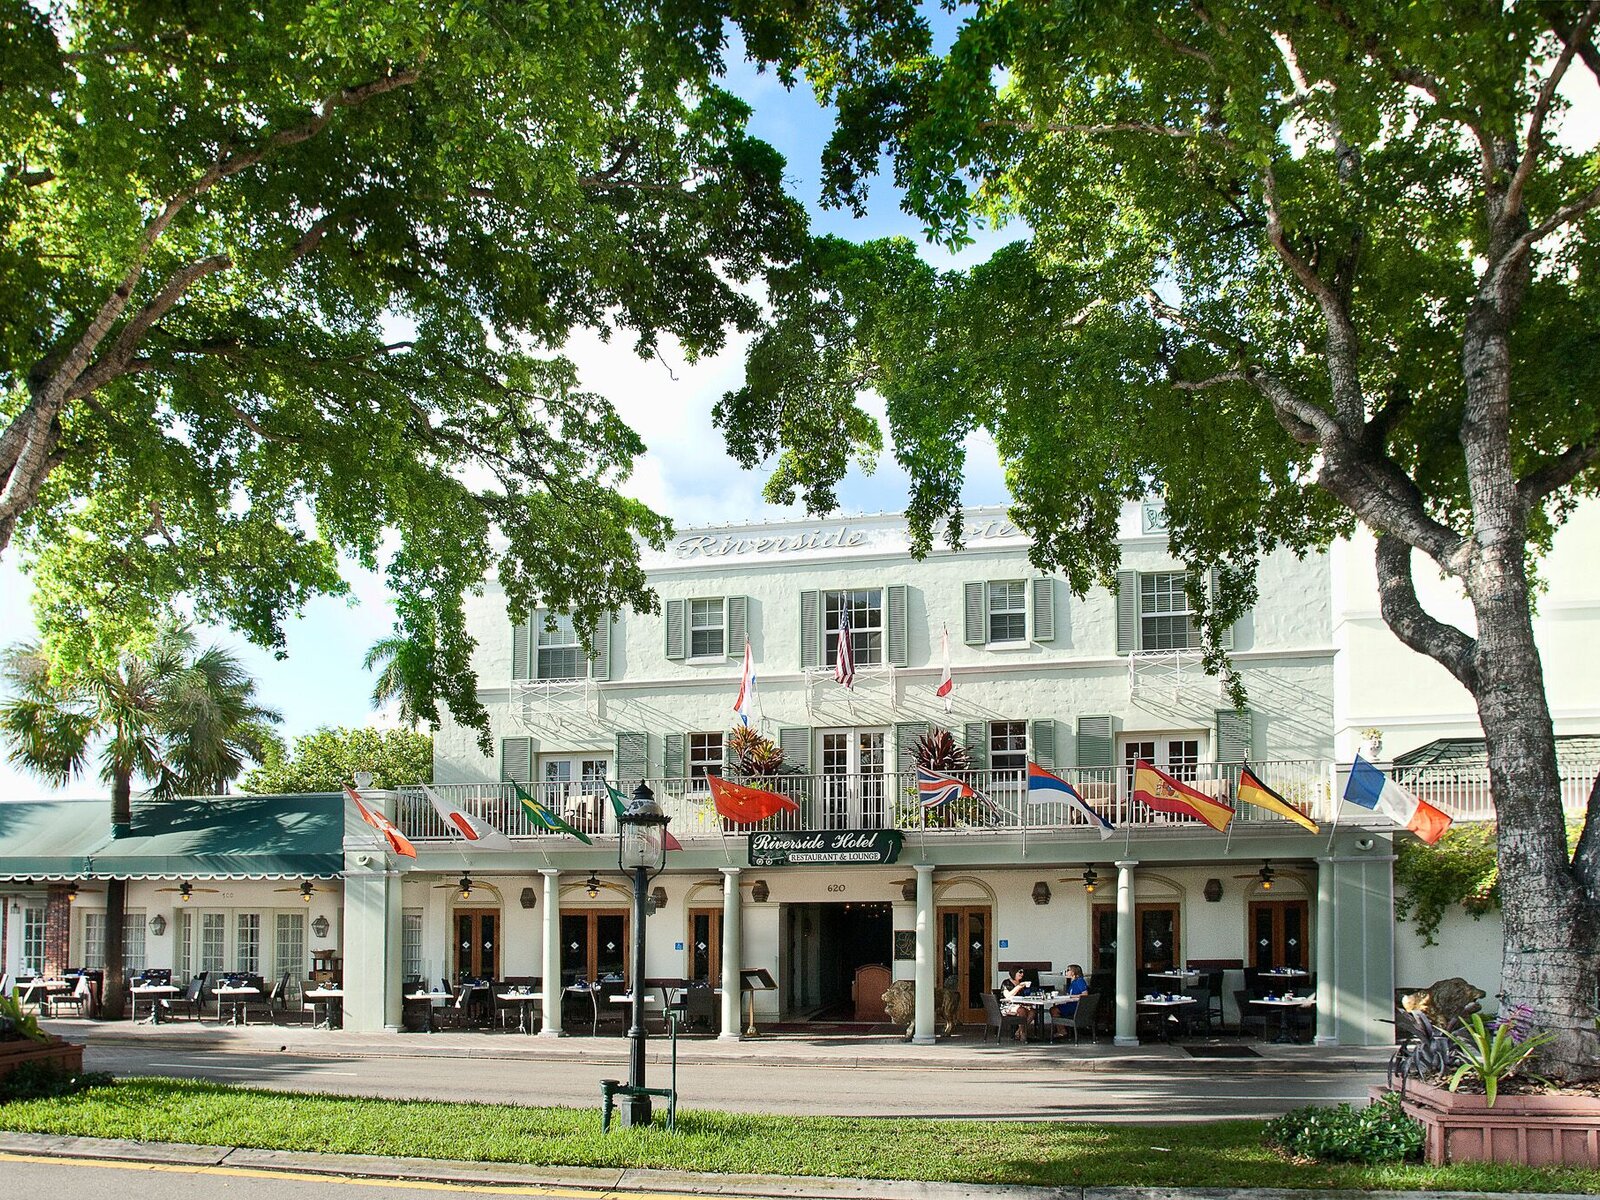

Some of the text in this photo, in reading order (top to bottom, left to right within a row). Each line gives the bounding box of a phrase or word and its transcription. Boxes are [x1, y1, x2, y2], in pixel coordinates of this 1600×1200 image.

[676, 527, 868, 559] Riverside
[753, 832, 879, 850] Riverside Hotel
[791, 852, 879, 861] RESTAURANT & LOUNGE
[827, 884, 846, 893] 620
